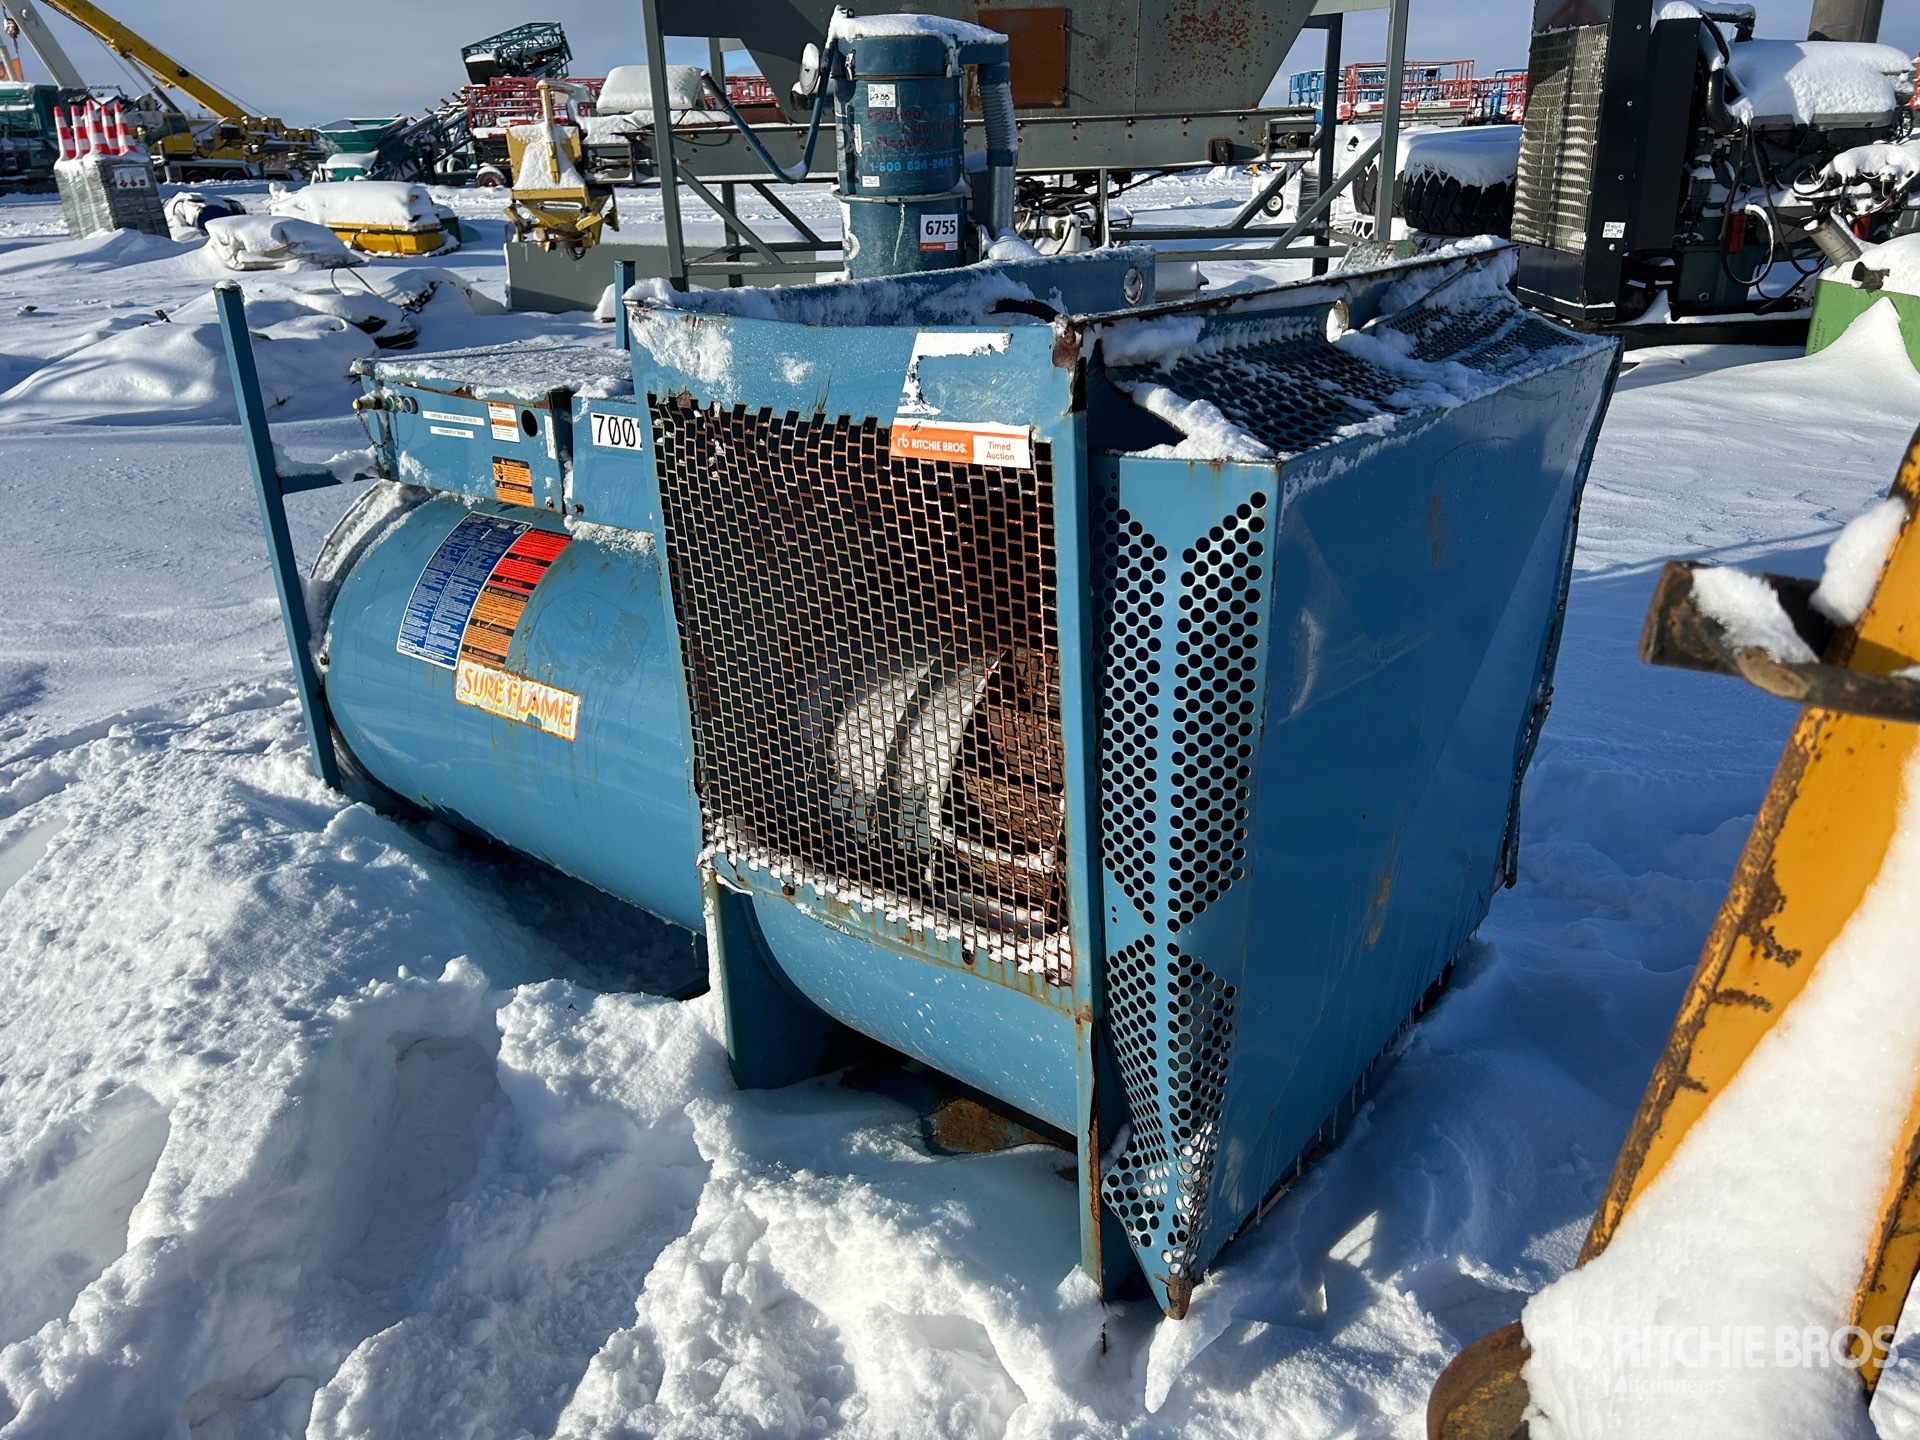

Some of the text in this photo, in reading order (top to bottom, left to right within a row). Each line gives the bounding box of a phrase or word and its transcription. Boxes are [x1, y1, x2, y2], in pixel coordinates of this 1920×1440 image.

[870, 161, 902, 172] 1-800
[926, 220, 956, 235] 6755
[593, 414, 642, 449] 700
[912, 439, 941, 451] RITCHIE
[988, 441, 1011, 451] Timed
[986, 452, 1015, 461] Auction
[462, 668, 573, 729] SURE FLAME
